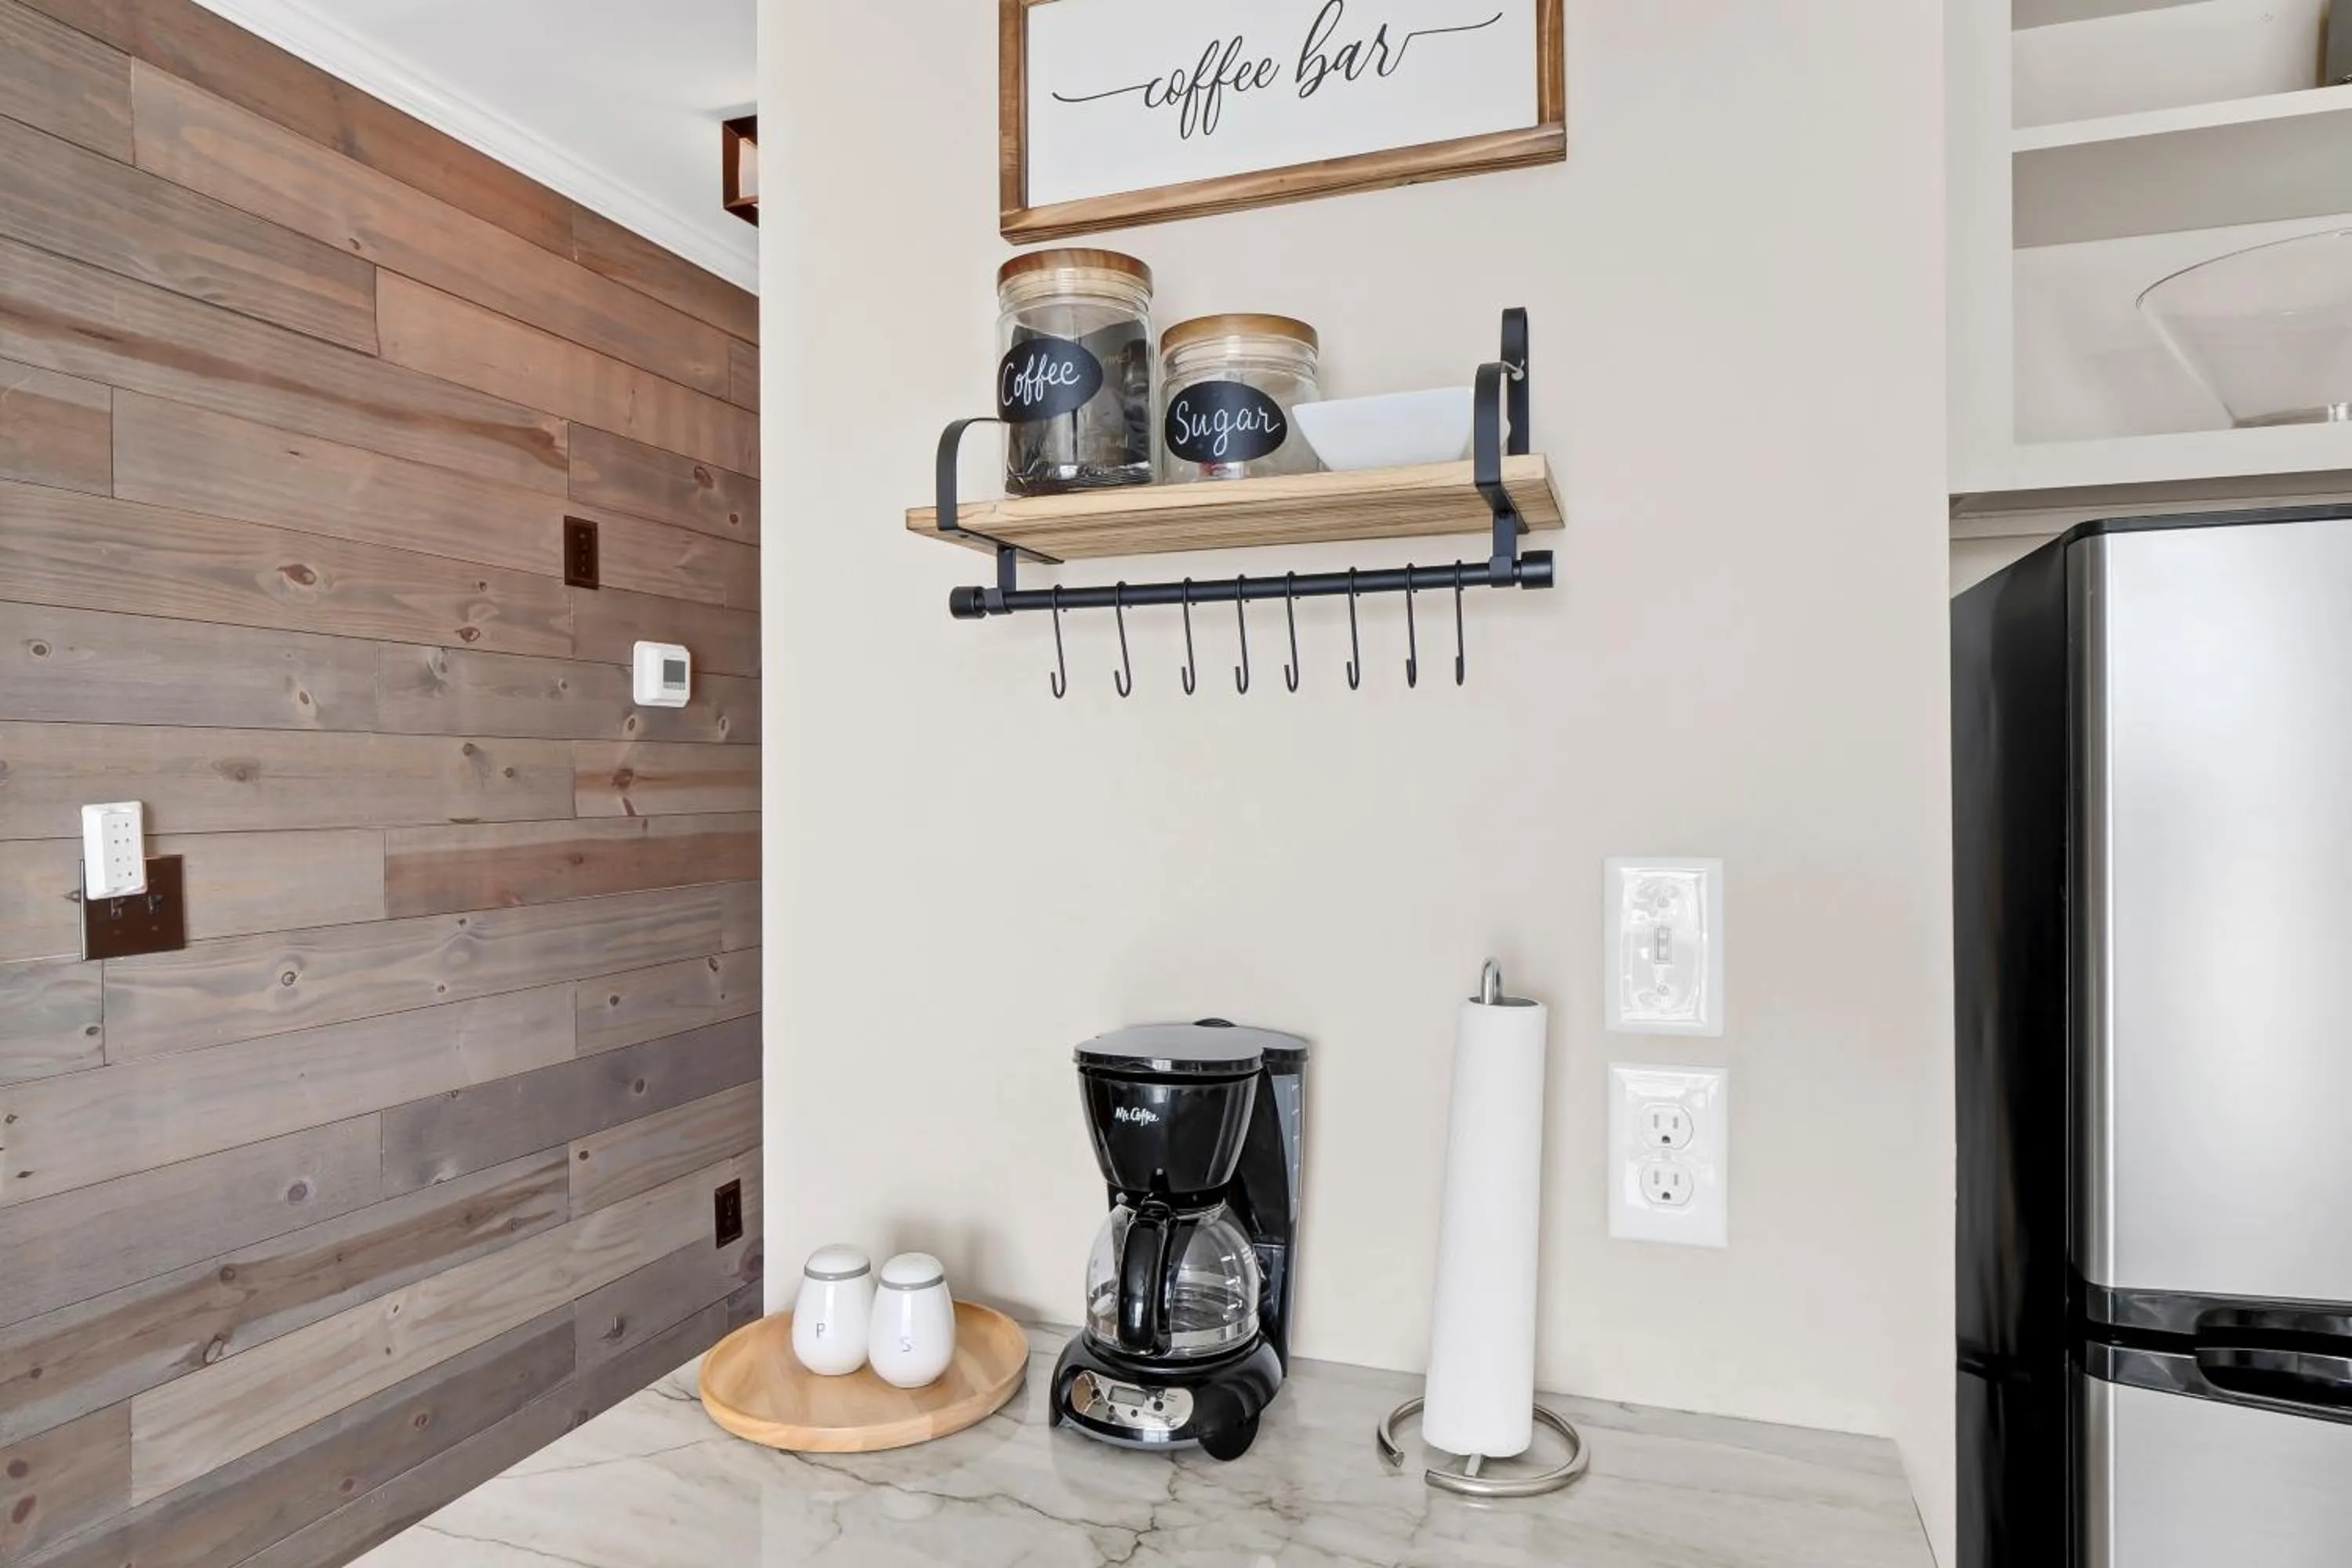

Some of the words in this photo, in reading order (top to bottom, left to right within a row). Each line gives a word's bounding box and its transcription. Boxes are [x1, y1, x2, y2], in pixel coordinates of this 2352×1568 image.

[1052, 34, 1281, 140] coffee
[1294, 0, 1502, 99] bar
[1001, 353, 1081, 406] Coffee
[1175, 401, 1279, 456] Sugar
[816, 1323, 826, 1338] P
[900, 1336, 913, 1352] S
